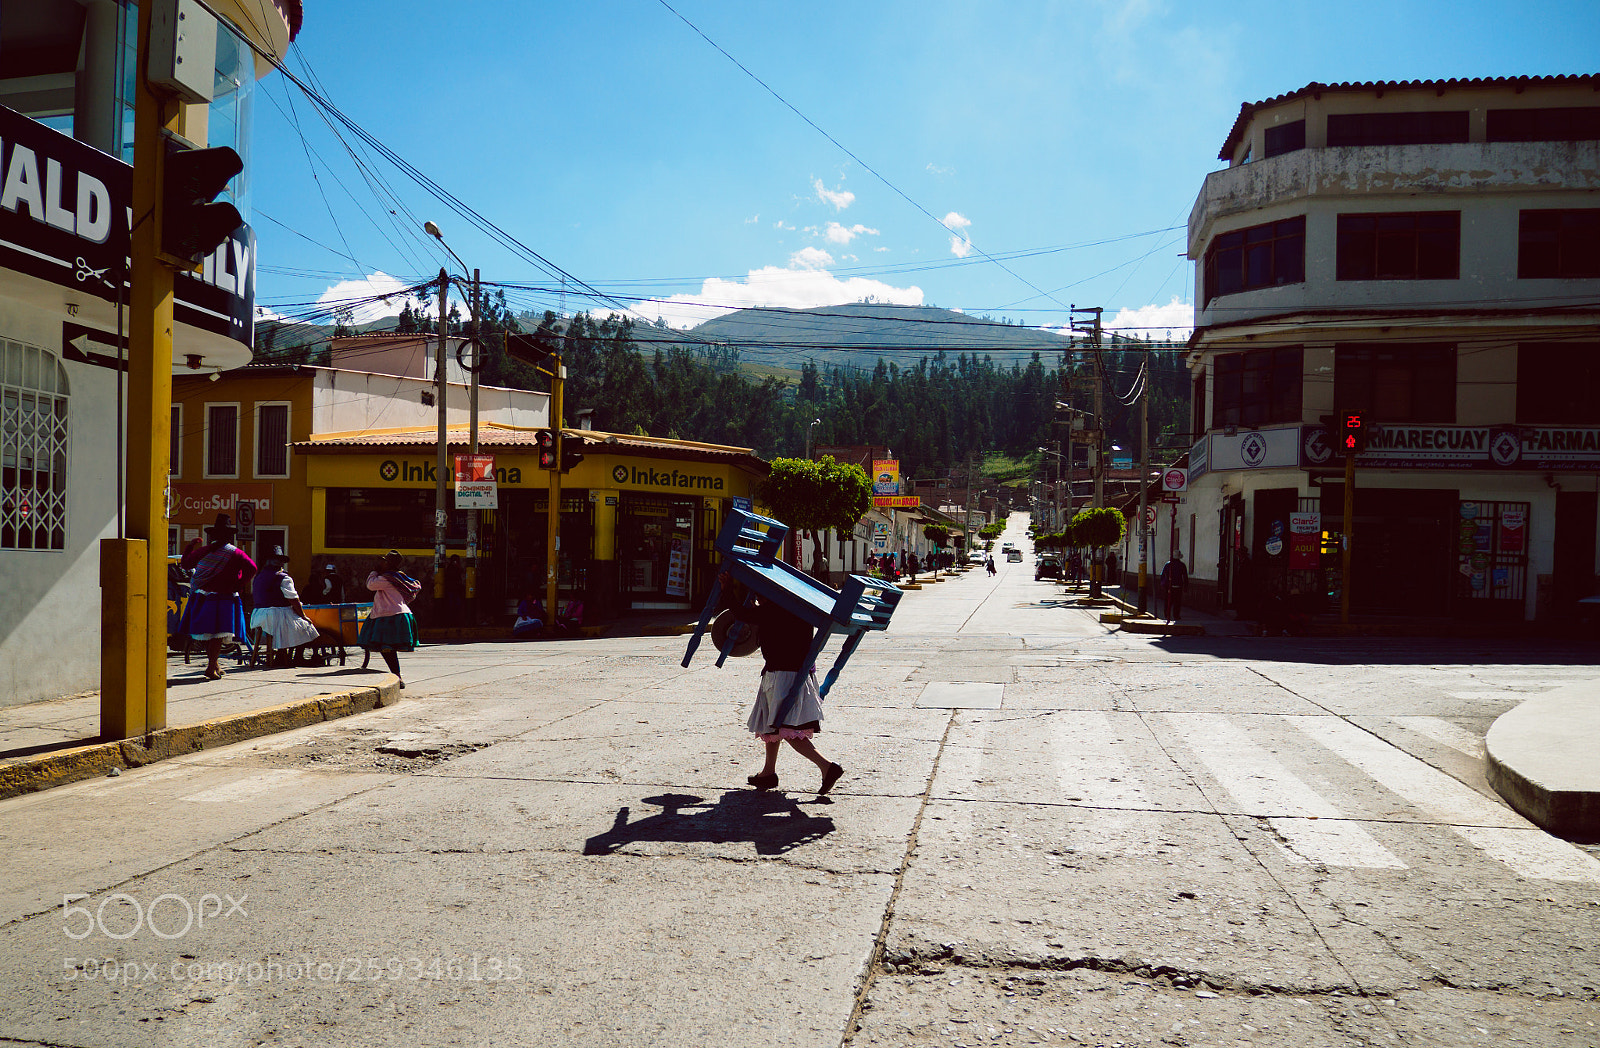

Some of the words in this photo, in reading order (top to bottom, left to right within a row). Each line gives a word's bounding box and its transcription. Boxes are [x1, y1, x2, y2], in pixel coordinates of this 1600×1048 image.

[0, 138, 111, 244] ALD
[1347, 416, 1361, 428] 25
[1366, 430, 1488, 450] RMARECUAY
[1528, 430, 1600, 451] FARMA
[631, 466, 724, 490] Inkafarma
[874, 497, 892, 507] POLLOS
[902, 497, 919, 507] BRASA
